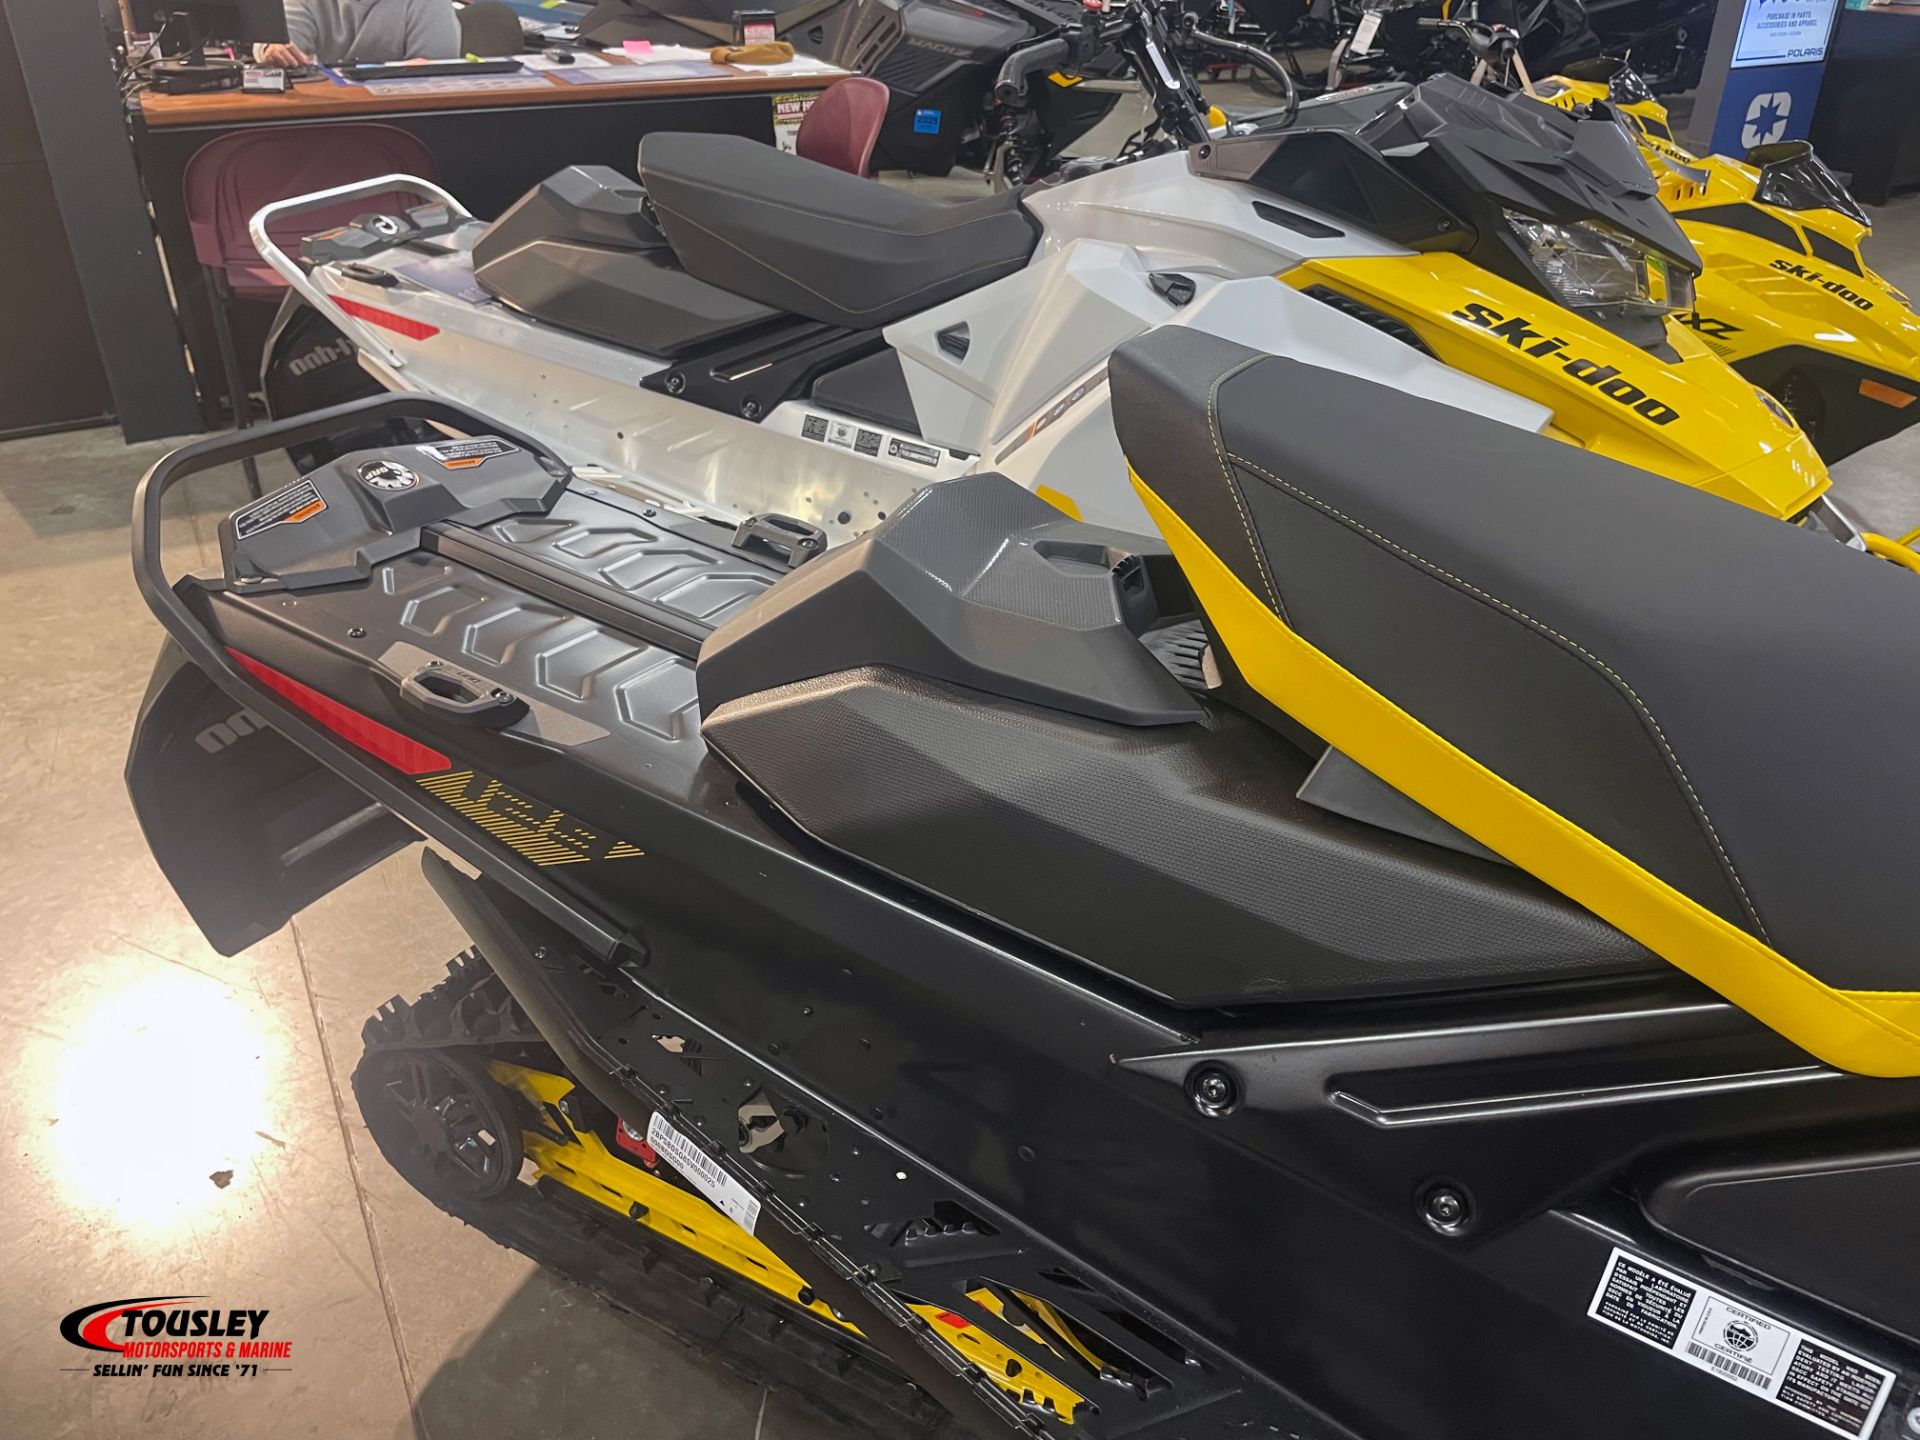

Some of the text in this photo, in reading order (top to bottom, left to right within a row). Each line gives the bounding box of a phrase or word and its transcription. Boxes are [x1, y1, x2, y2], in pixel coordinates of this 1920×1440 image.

[1787, 48, 1824, 58] POLARIS
[777, 101, 800, 114] NEW
[1769, 259, 1874, 311] ski-doo
[1452, 303, 1680, 425] ski-doo
[365, 466, 389, 480] BRP
[1726, 1307, 1770, 1329] CERTIFIED
[1714, 1343, 1752, 1363] CERTIFIÉ
